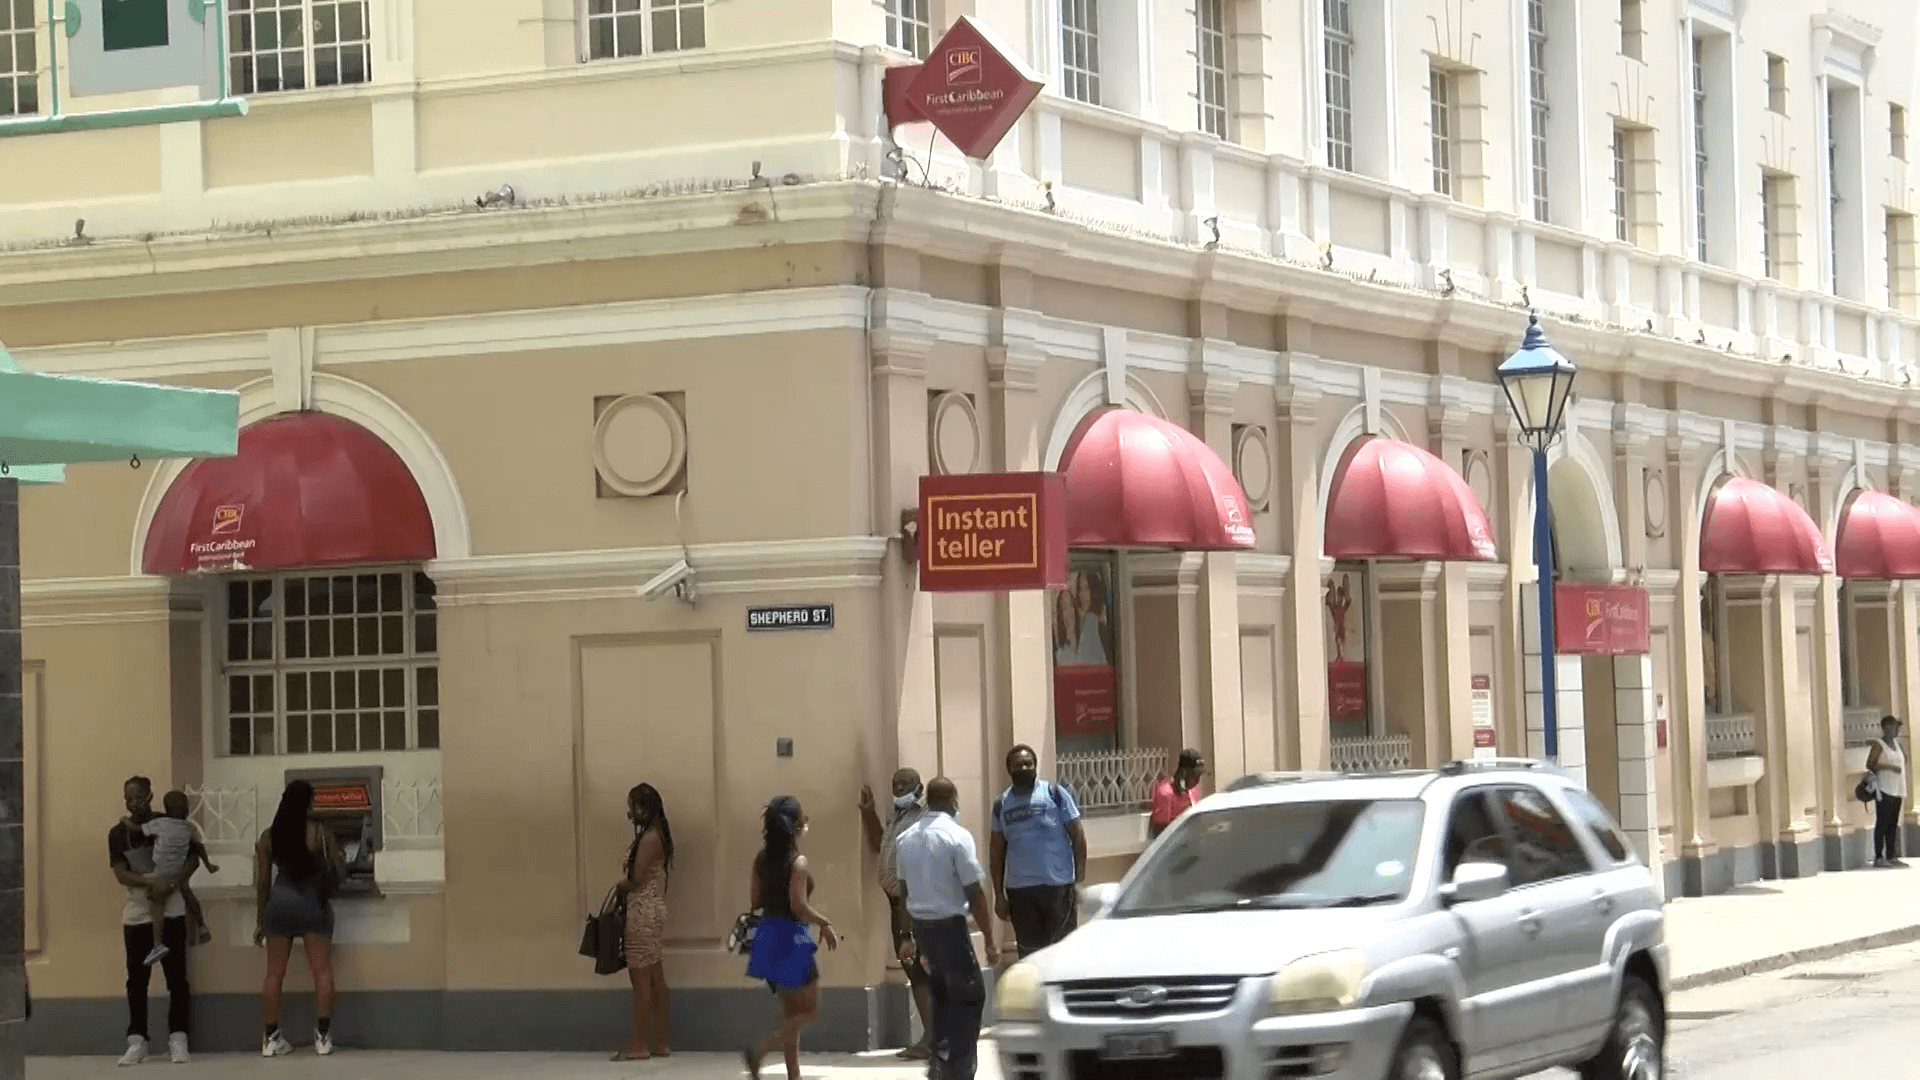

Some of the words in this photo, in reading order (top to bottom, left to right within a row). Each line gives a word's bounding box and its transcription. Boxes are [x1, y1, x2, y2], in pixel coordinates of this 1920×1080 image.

[949, 51, 979, 66] CIBC
[926, 89, 1004, 105] FirstCaribbean
[937, 505, 1028, 530] Instant
[190, 539, 256, 554] FirstCaribbean
[937, 532, 1005, 559] teller
[750, 610, 809, 626] SHEPHERD
